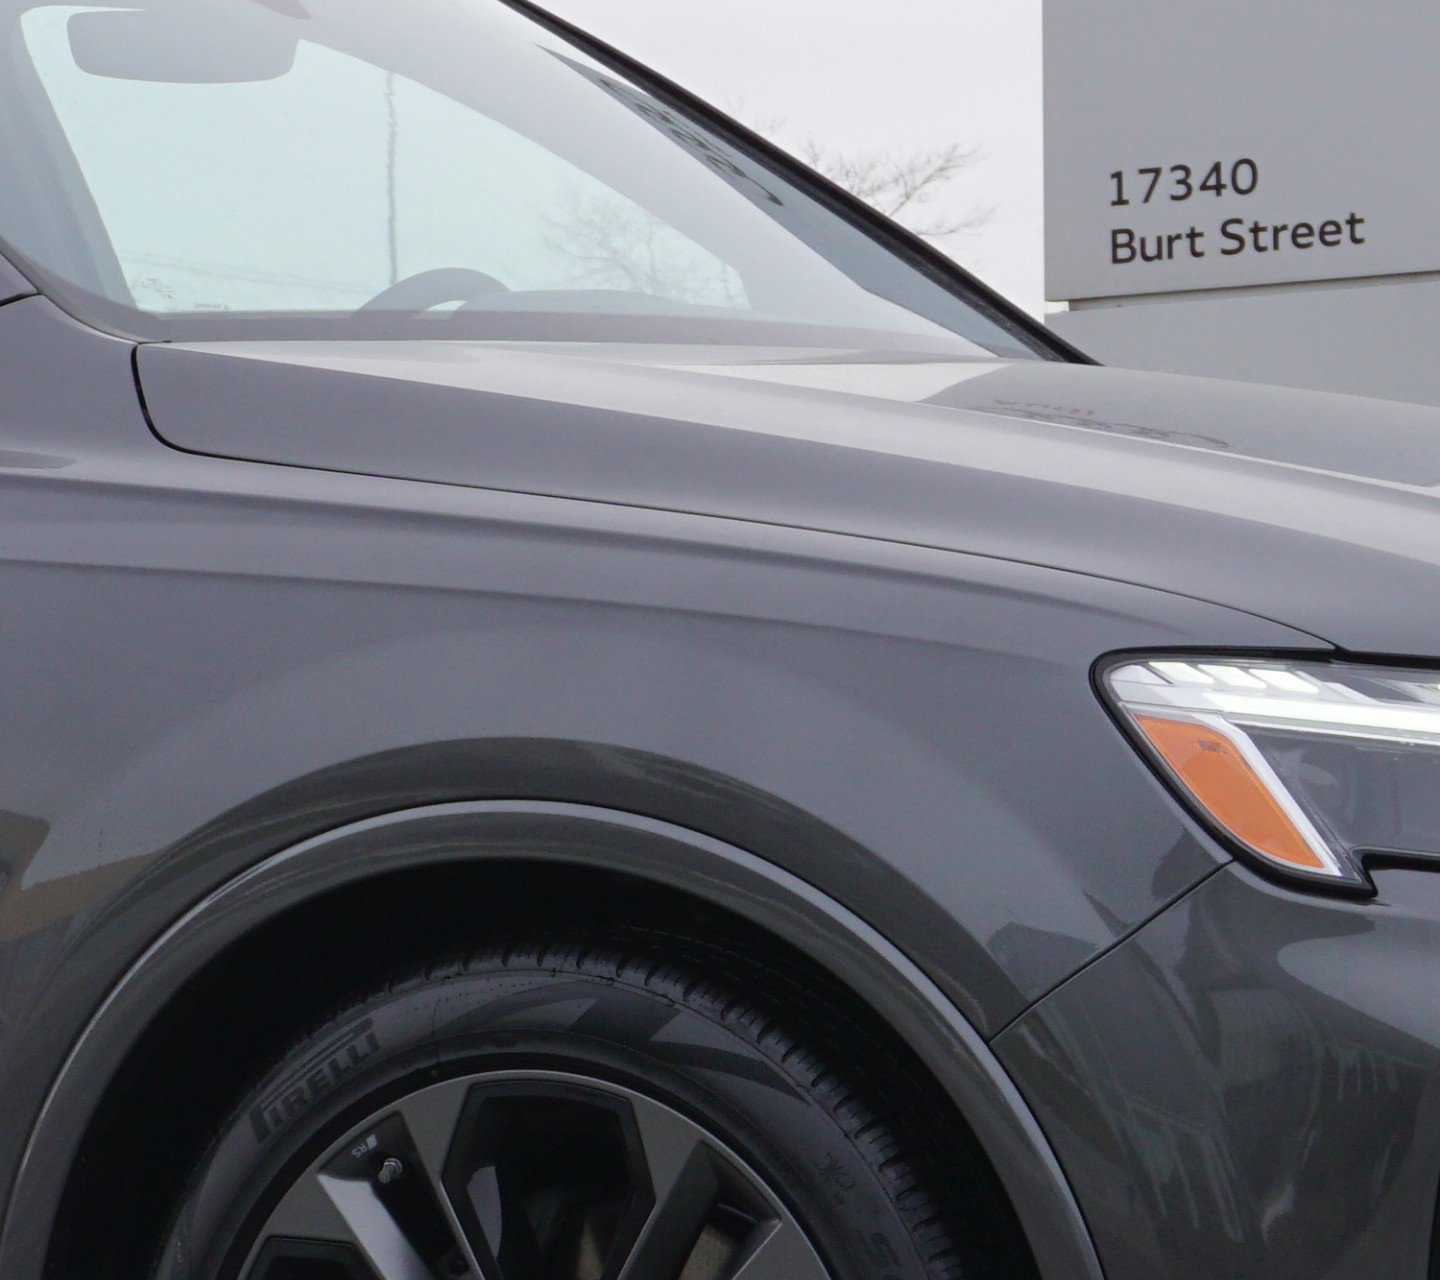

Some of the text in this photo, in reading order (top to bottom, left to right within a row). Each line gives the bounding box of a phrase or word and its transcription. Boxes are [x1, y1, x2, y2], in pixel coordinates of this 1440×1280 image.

[1109, 157, 1258, 206] 17340
[1111, 212, 1365, 264] Burt Street
[248, 1016, 381, 1144] PIRELLI
